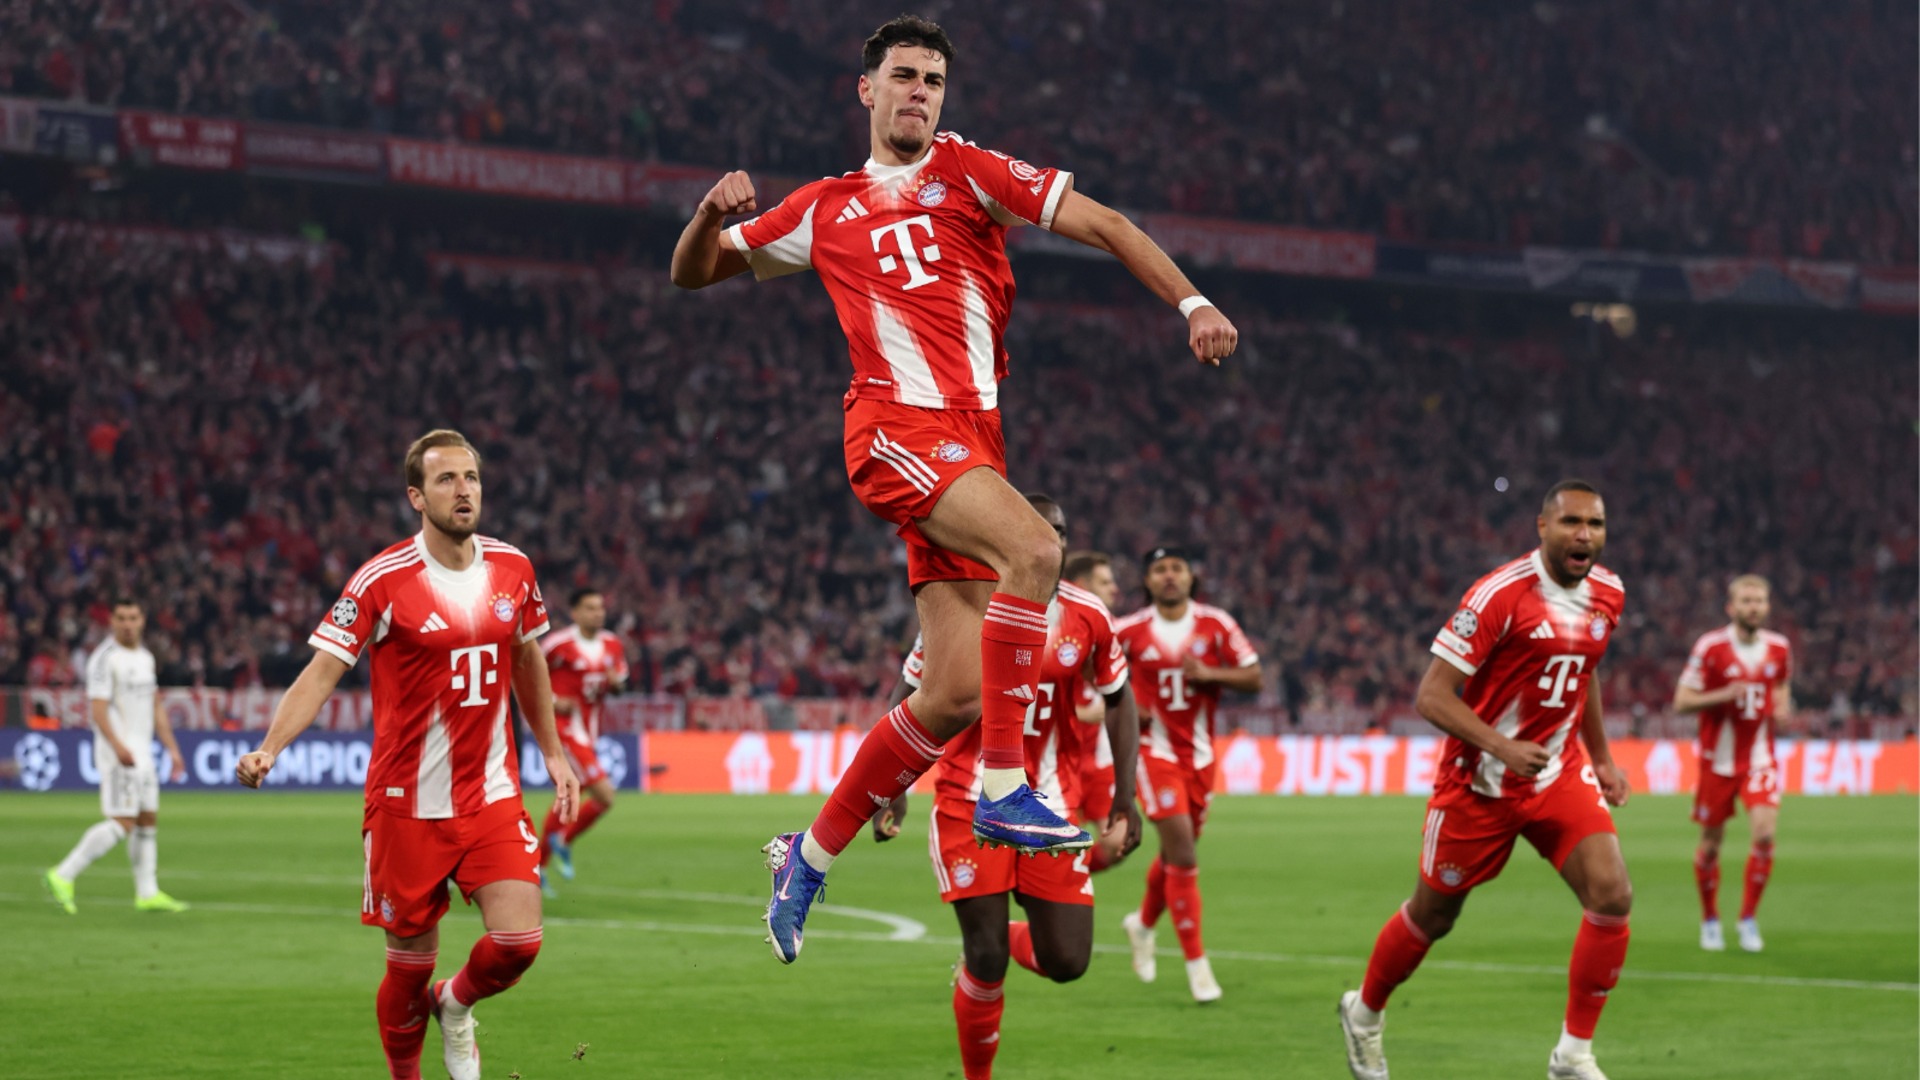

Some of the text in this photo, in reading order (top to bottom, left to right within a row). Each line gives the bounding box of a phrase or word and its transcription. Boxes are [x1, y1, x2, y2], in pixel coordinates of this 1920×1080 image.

[870, 214, 941, 291] T
[450, 643, 498, 707] T
[1538, 654, 1586, 708] T
[1276, 735, 1398, 796] JUST
[1802, 739, 1883, 795] EAT
